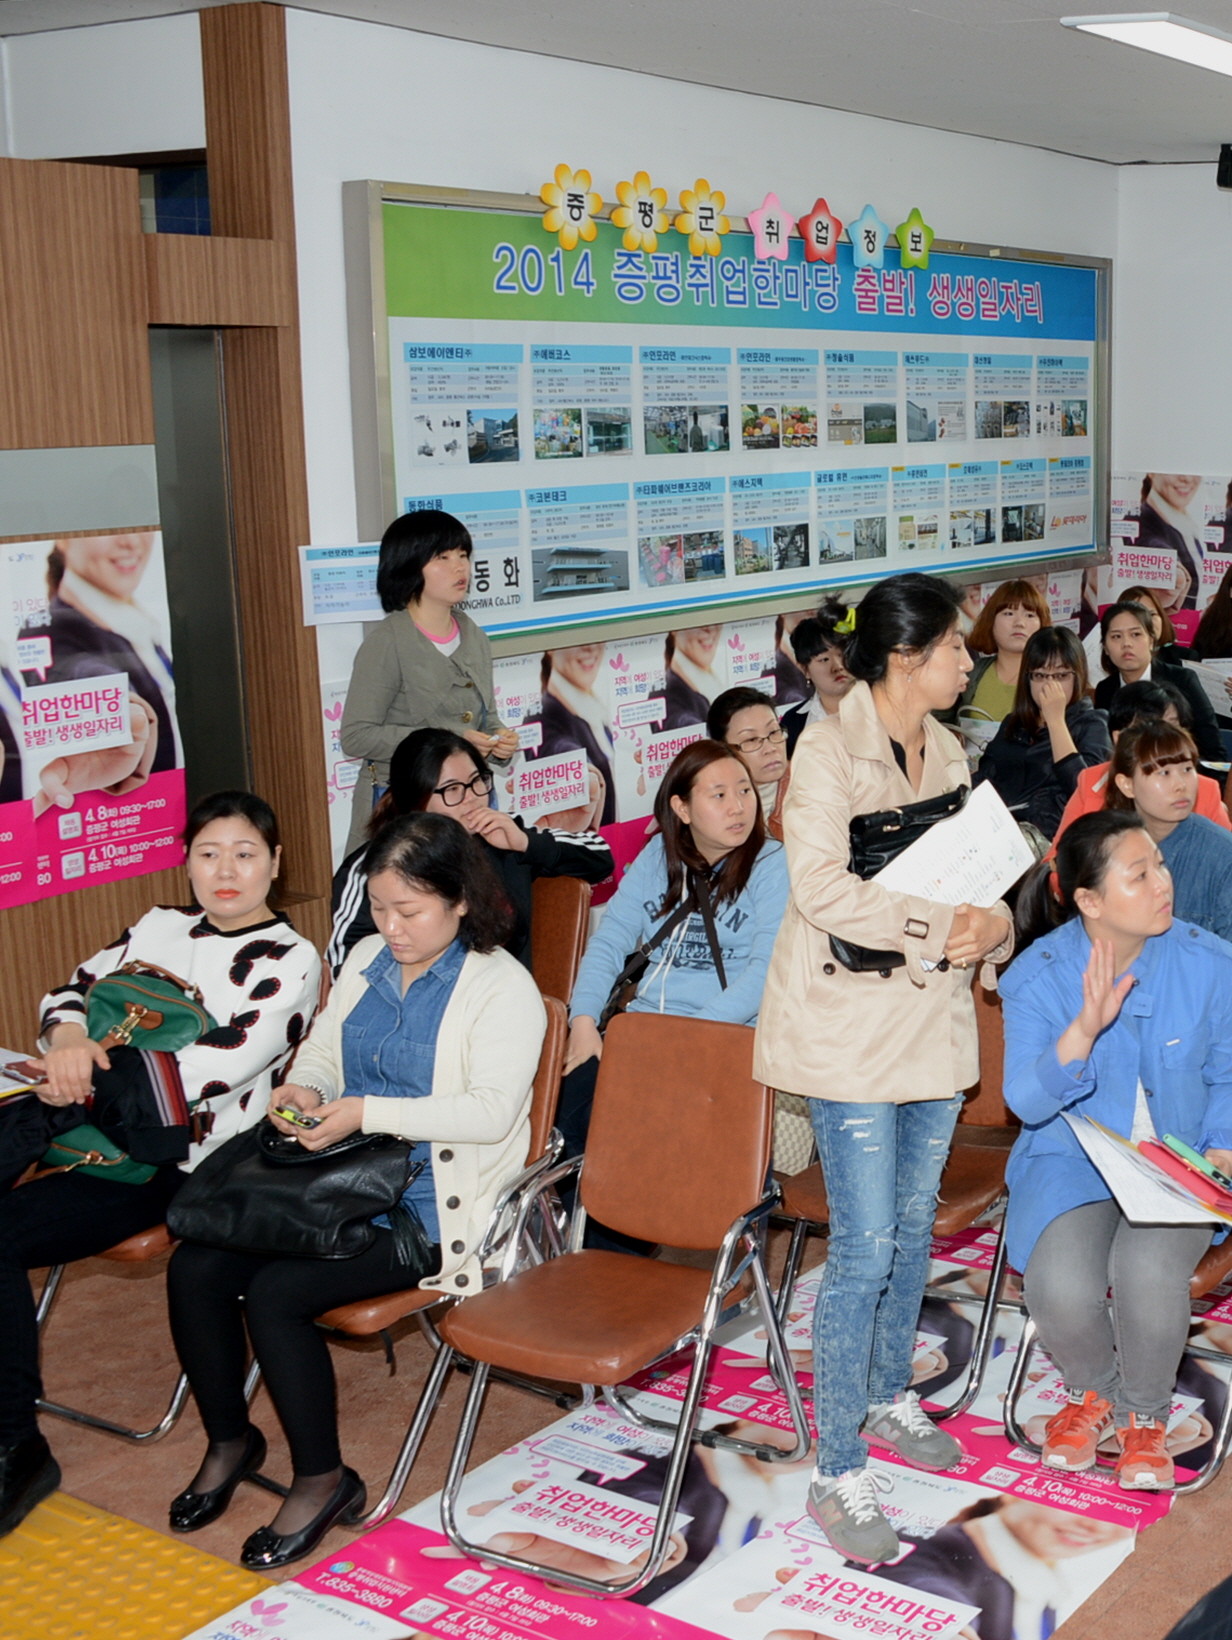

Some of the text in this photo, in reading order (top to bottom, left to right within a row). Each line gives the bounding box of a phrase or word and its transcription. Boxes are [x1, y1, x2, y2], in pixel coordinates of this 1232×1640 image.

[493, 244, 1045, 324] 2014 증평취업한마당 출발! 생생일자리
[1117, 553, 1174, 571] 취업한마당
[54, 716, 123, 743] 생생일자리
[518, 759, 584, 792] 취업한마당
[518, 782, 585, 810] 출발! 생생일자리
[536, 1484, 658, 1537] 취업한마당
[1077, 1492, 1143, 1515] 10:00~12:00
[511, 1501, 643, 1549] 출발! 생생일자리
[315, 1571, 395, 1609] T.835-3880
[803, 1572, 958, 1633] 취업한마당
[533, 1599, 599, 1628] 09:30~17:00
[780, 1593, 936, 1640] 출발! 생생일자리
